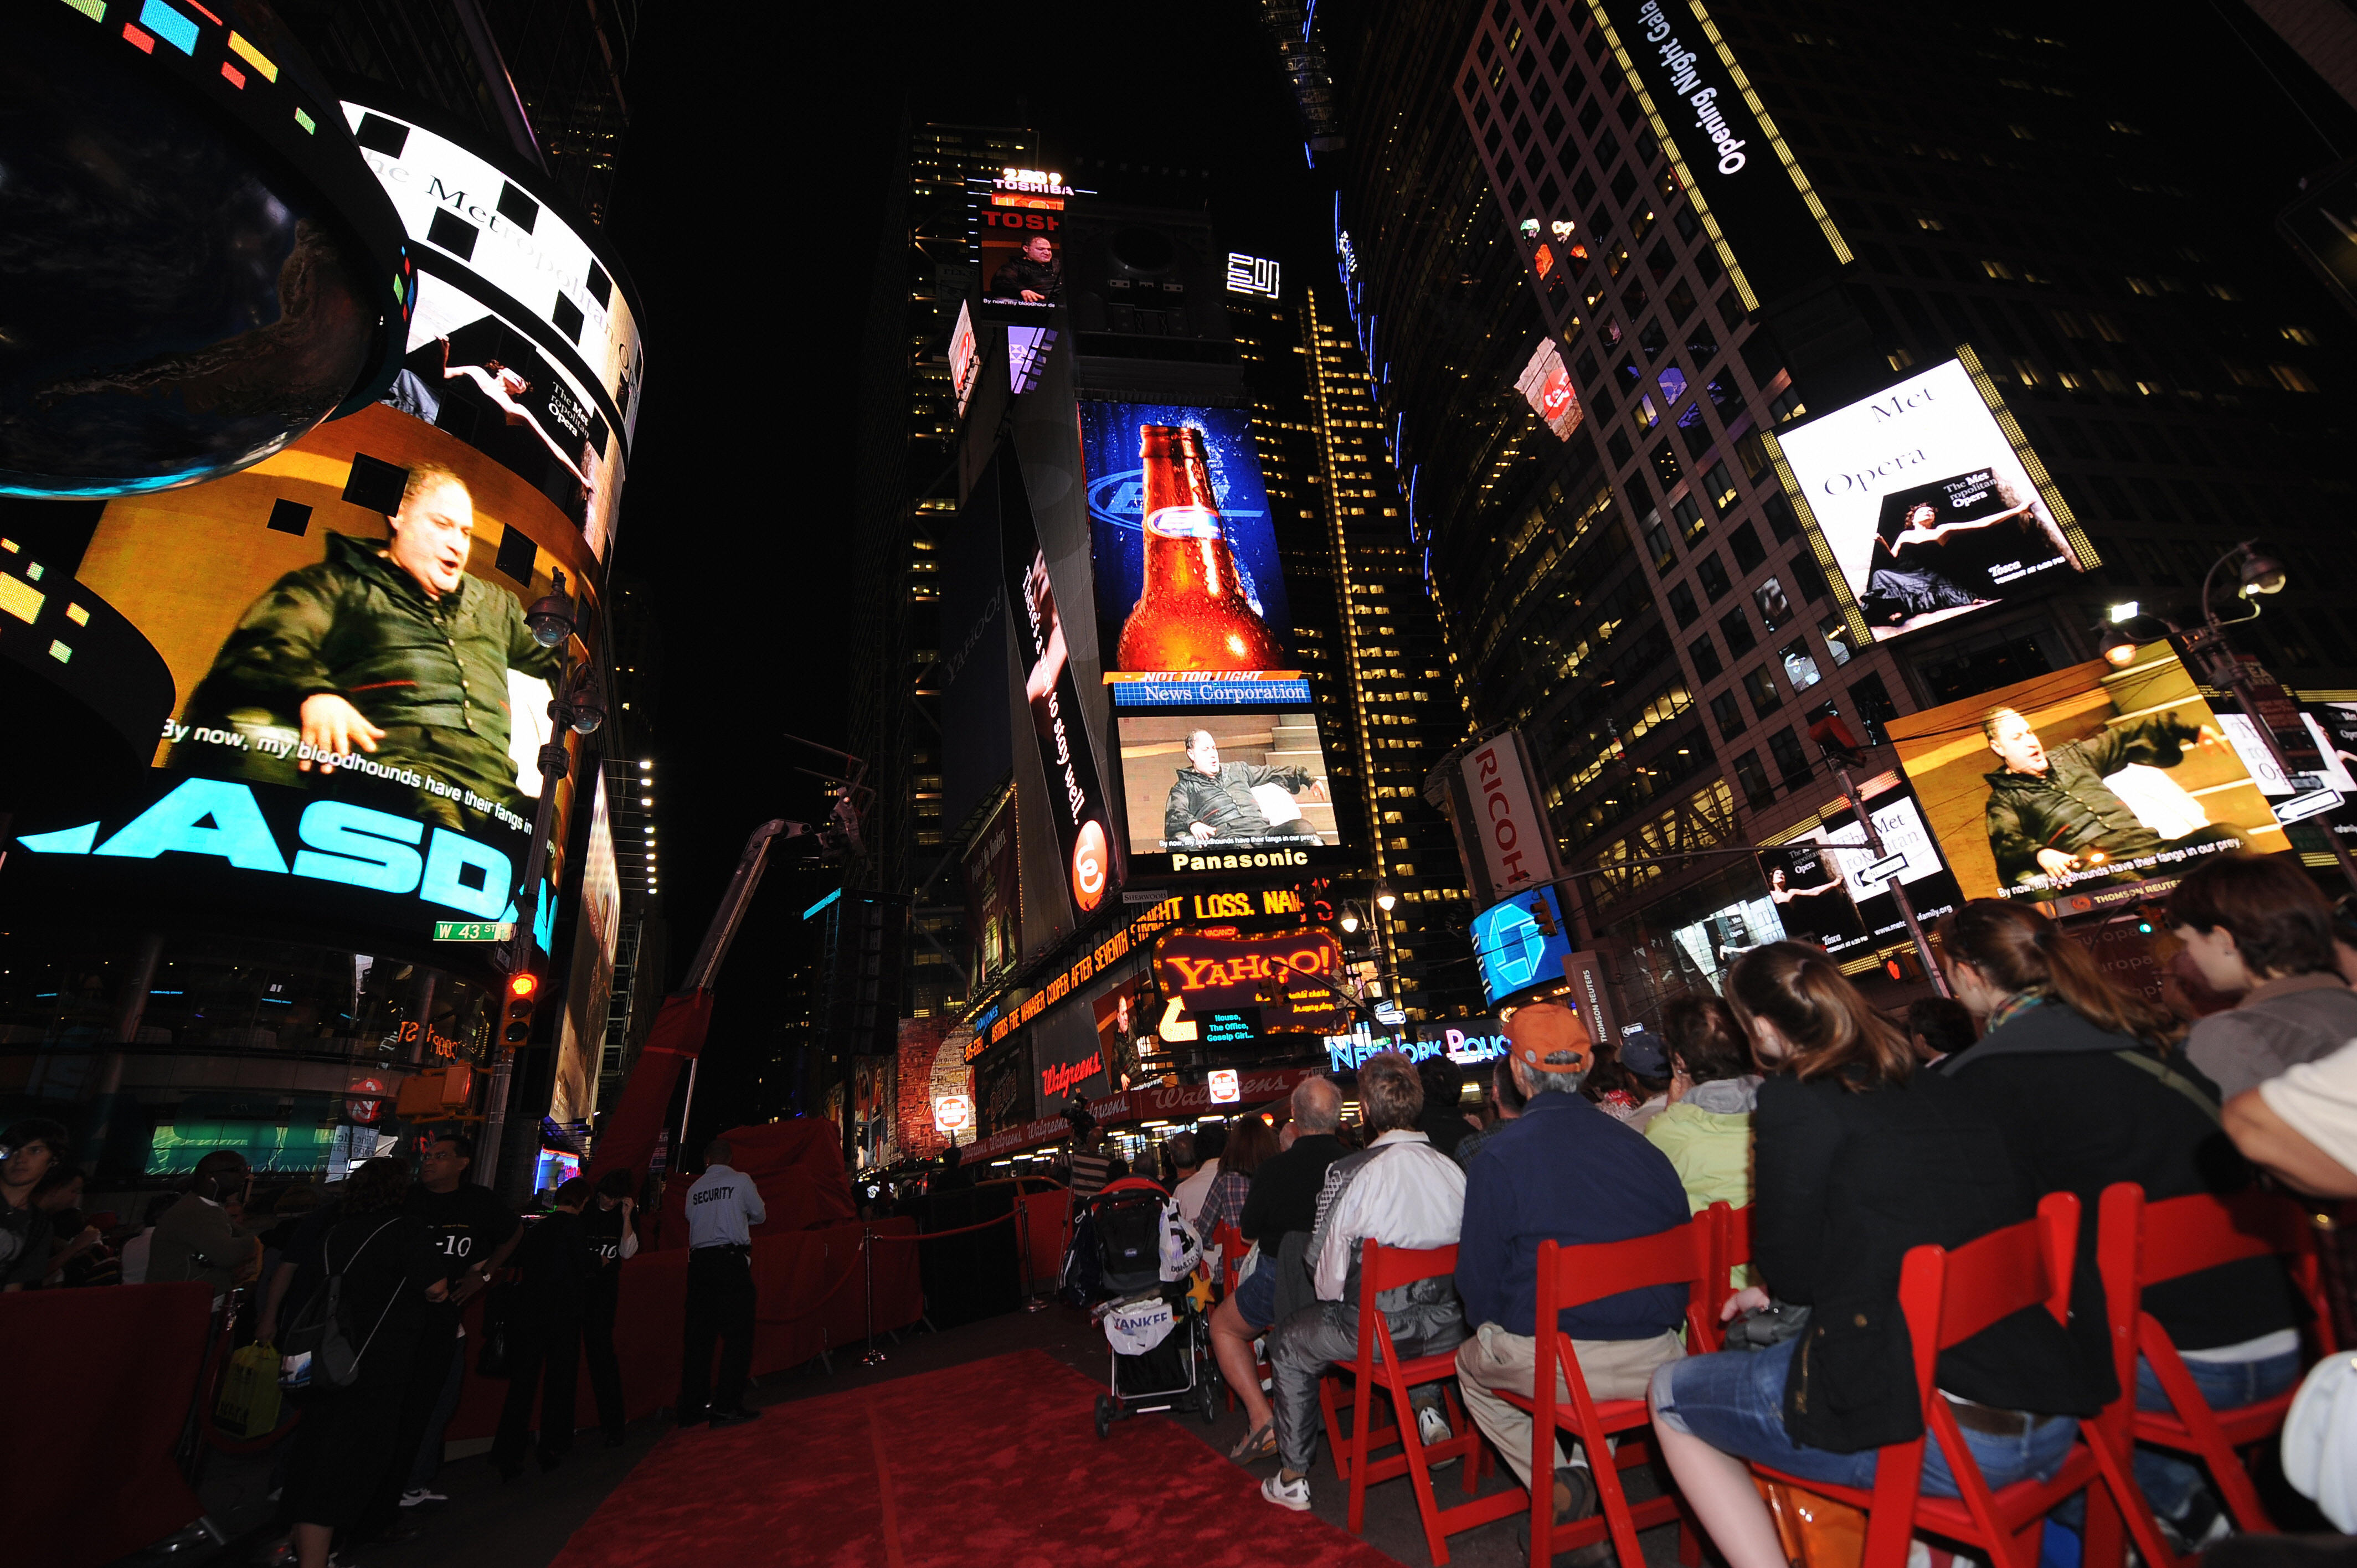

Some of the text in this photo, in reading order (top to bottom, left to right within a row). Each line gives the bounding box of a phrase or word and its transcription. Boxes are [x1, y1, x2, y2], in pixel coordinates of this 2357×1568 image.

[1638, 0, 1746, 174] Opening Night Gala
[993, 178, 1074, 195] TOSHIBA
[553, 381, 589, 426] The Met
[1870, 388, 1937, 423] Met
[548, 403, 578, 437] Opera
[551, 395, 589, 439] ropolitan
[1824, 450, 1927, 495] Opera
[1943, 472, 1990, 493] The Met
[1949, 479, 1998, 501] ropolitan
[1952, 491, 1988, 508] Opera
[1988, 561, 2022, 577] Tosca
[1022, 565, 1085, 825] There's a way to stay well.
[1144, 683, 1305, 704] News Corporation
[194, 726, 249, 751] now,
[256, 737, 293, 760] my
[297, 741, 421, 787] bloodhounds
[424, 775, 461, 801] have
[464, 790, 494, 813] their
[495, 803, 523, 831] fangs
[523, 818, 533, 835] in
[1475, 747, 1527, 885] RICOH
[1172, 848, 1308, 871] Panasonic
[1795, 861, 1816, 874] Opera
[1997, 888, 2011, 899] By
[2011, 884, 2034, 894] now,
[2035, 880, 2049, 891] my
[2108, 863, 2135, 875] have
[2134, 857, 2157, 869] their
[2157, 851, 2187, 864] fangs
[2186, 847, 2198, 856] in
[2198, 844, 2216, 854] our
[2215, 837, 2244, 853] prey.
[1124, 893, 1167, 901] SHERWOOD
[2094, 887, 2144, 904] THOMSON
[439, 924, 452, 938] W
[458, 925, 480, 939] 43
[1204, 927, 1236, 937] VACANCY
[1821, 934, 1842, 946] Tosca
[992, 1017, 1008, 1044] ASTROS
[1021, 990, 1046, 1024] MANAGER
[1047, 972, 1069, 1005] COOPER
[1071, 955, 1093, 989] AFTER
[1094, 929, 1129, 972] SEVENTH
[1194, 892, 1255, 919] LOSS.
[1166, 946, 1330, 990] YAHOO!
[1583, 969, 1608, 1043] REUTERS THOMSON
[1207, 1034, 1233, 1042] Gossip
[1042, 1051, 1102, 1099] Walgreens
[1027, 1118, 1069, 1142] Walgreens
[990, 1130, 1022, 1154] Walgreens
[693, 1187, 734, 1205] SECURITY
[436, 1235, 471, 1257] -10
